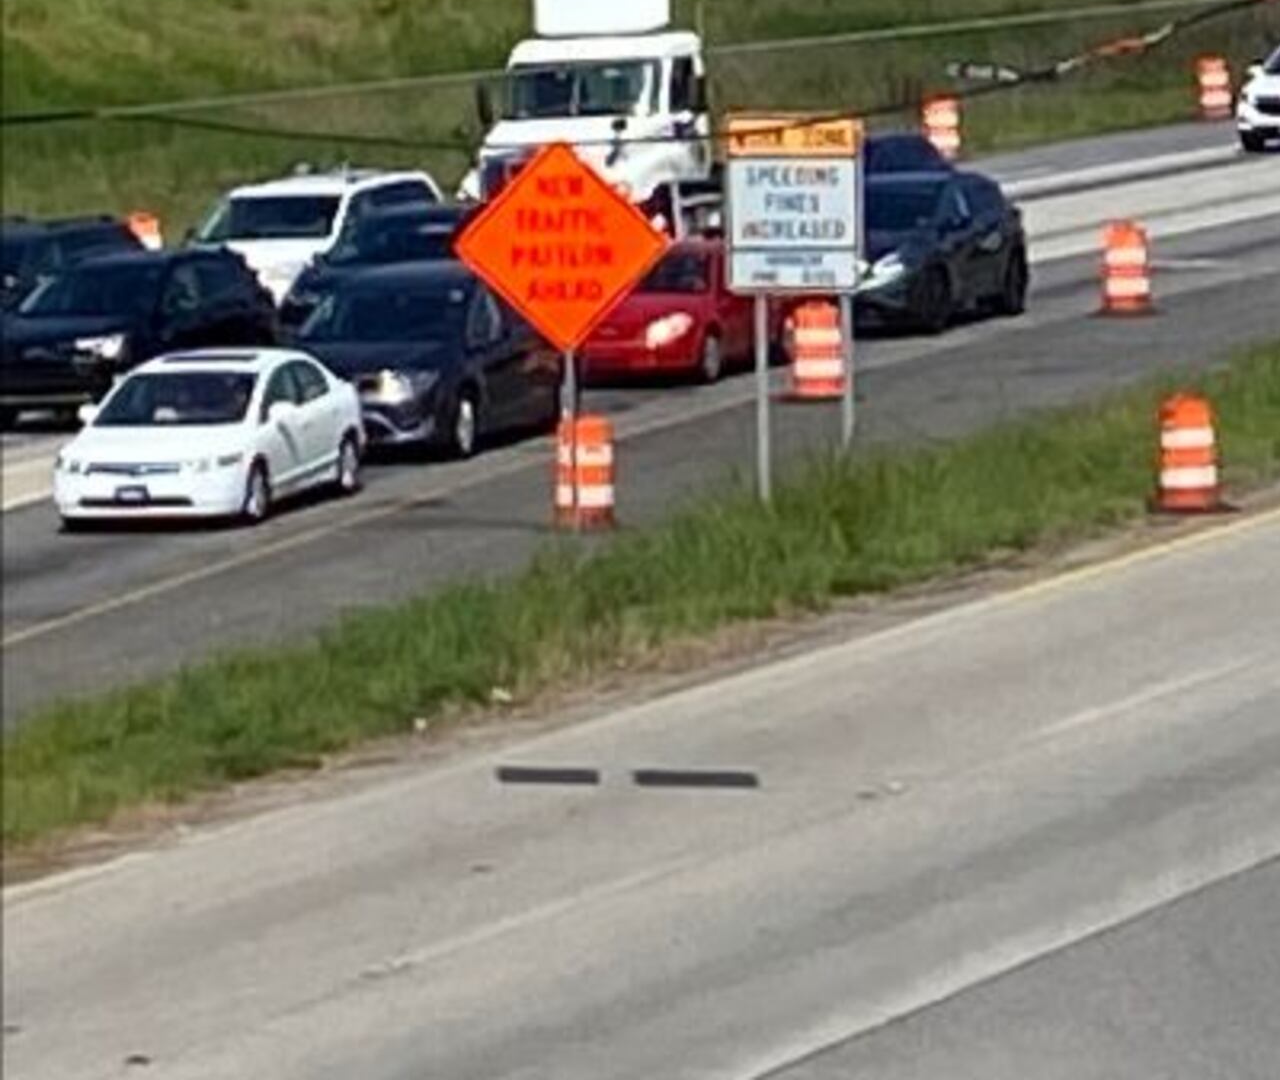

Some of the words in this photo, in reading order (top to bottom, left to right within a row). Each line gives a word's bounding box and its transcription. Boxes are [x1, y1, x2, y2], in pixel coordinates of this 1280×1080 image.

[538, 175, 583, 198] NEW
[745, 165, 840, 187] SPEEDING
[763, 192, 820, 214] FINES
[741, 219, 847, 241] INCREASED
